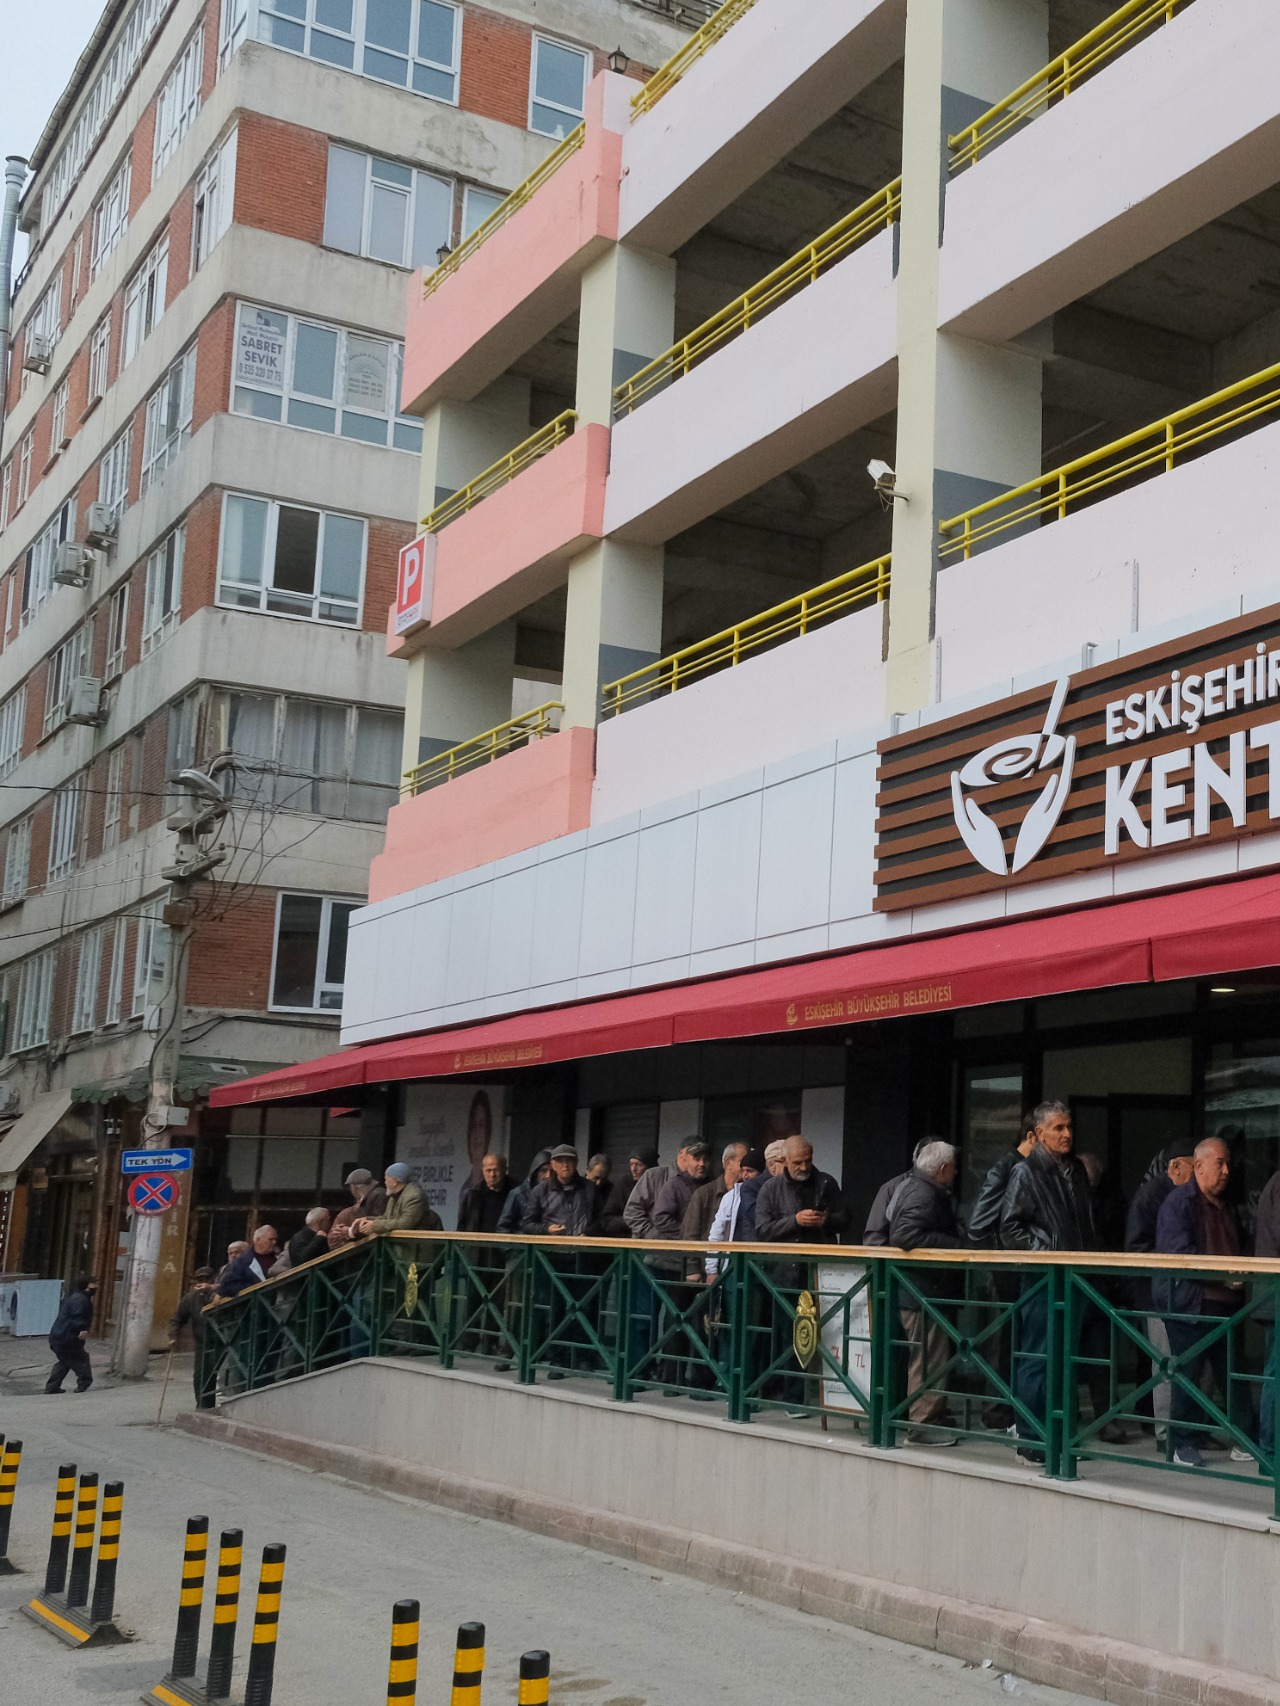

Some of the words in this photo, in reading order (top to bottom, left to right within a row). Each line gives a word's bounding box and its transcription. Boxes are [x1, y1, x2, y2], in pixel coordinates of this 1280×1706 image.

[241, 335, 283, 355] SABRET
[244, 350, 278, 368] SEVİK
[402, 547, 420, 606] P
[804, 1001, 844, 1021] ESKİŞEHİR
[847, 990, 900, 1015] BÜYÜKŞEHİR
[903, 982, 952, 1007] BELEDİYESİ
[128, 1158, 148, 1166] TEK
[151, 1157, 172, 1165] YÖN
